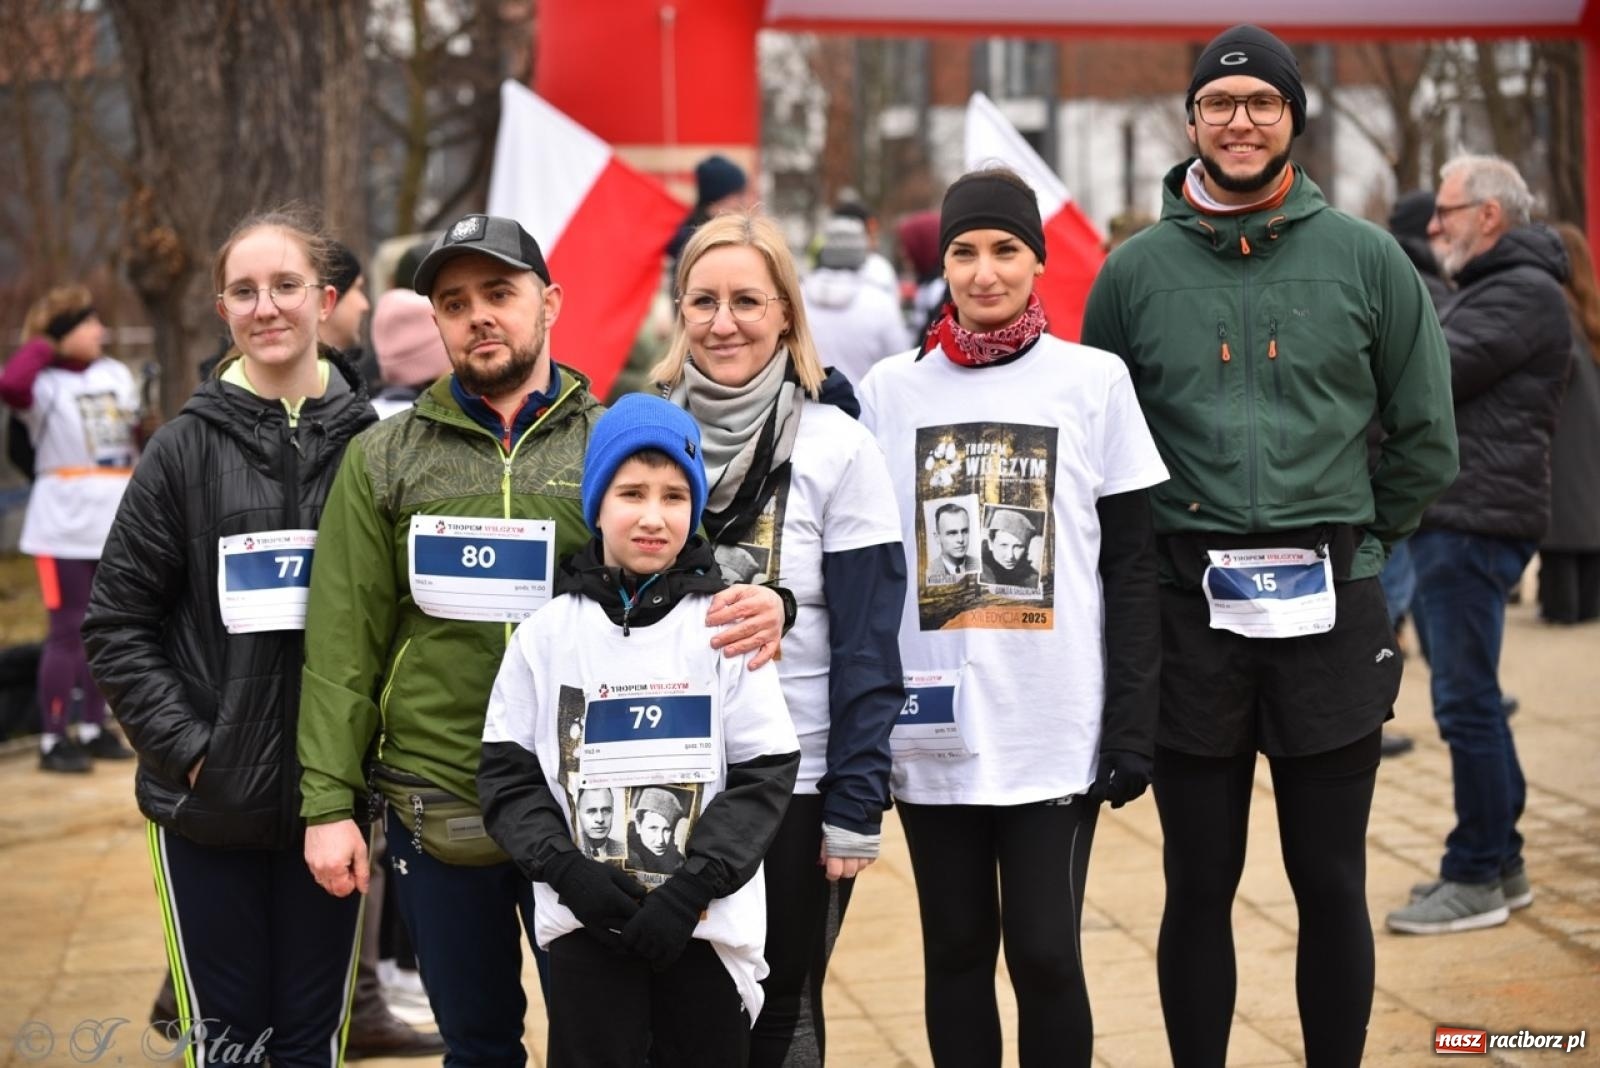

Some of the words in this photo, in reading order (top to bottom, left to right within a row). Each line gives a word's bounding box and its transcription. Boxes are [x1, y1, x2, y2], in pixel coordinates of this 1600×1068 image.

[965, 443, 1008, 455] TROPEM
[965, 457, 1048, 479] WILCZYM
[447, 523, 483, 532] TROPEM
[484, 525, 525, 534] WILCZYM
[461, 544, 496, 568] 80
[274, 555, 304, 578] 77
[1252, 572, 1277, 592] 15
[985, 611, 1021, 624] EDYCJA
[1021, 612, 1047, 624] 2025
[610, 683, 648, 693] TROPEM
[649, 682, 690, 691] WILCZYM
[629, 704, 662, 729] 79
